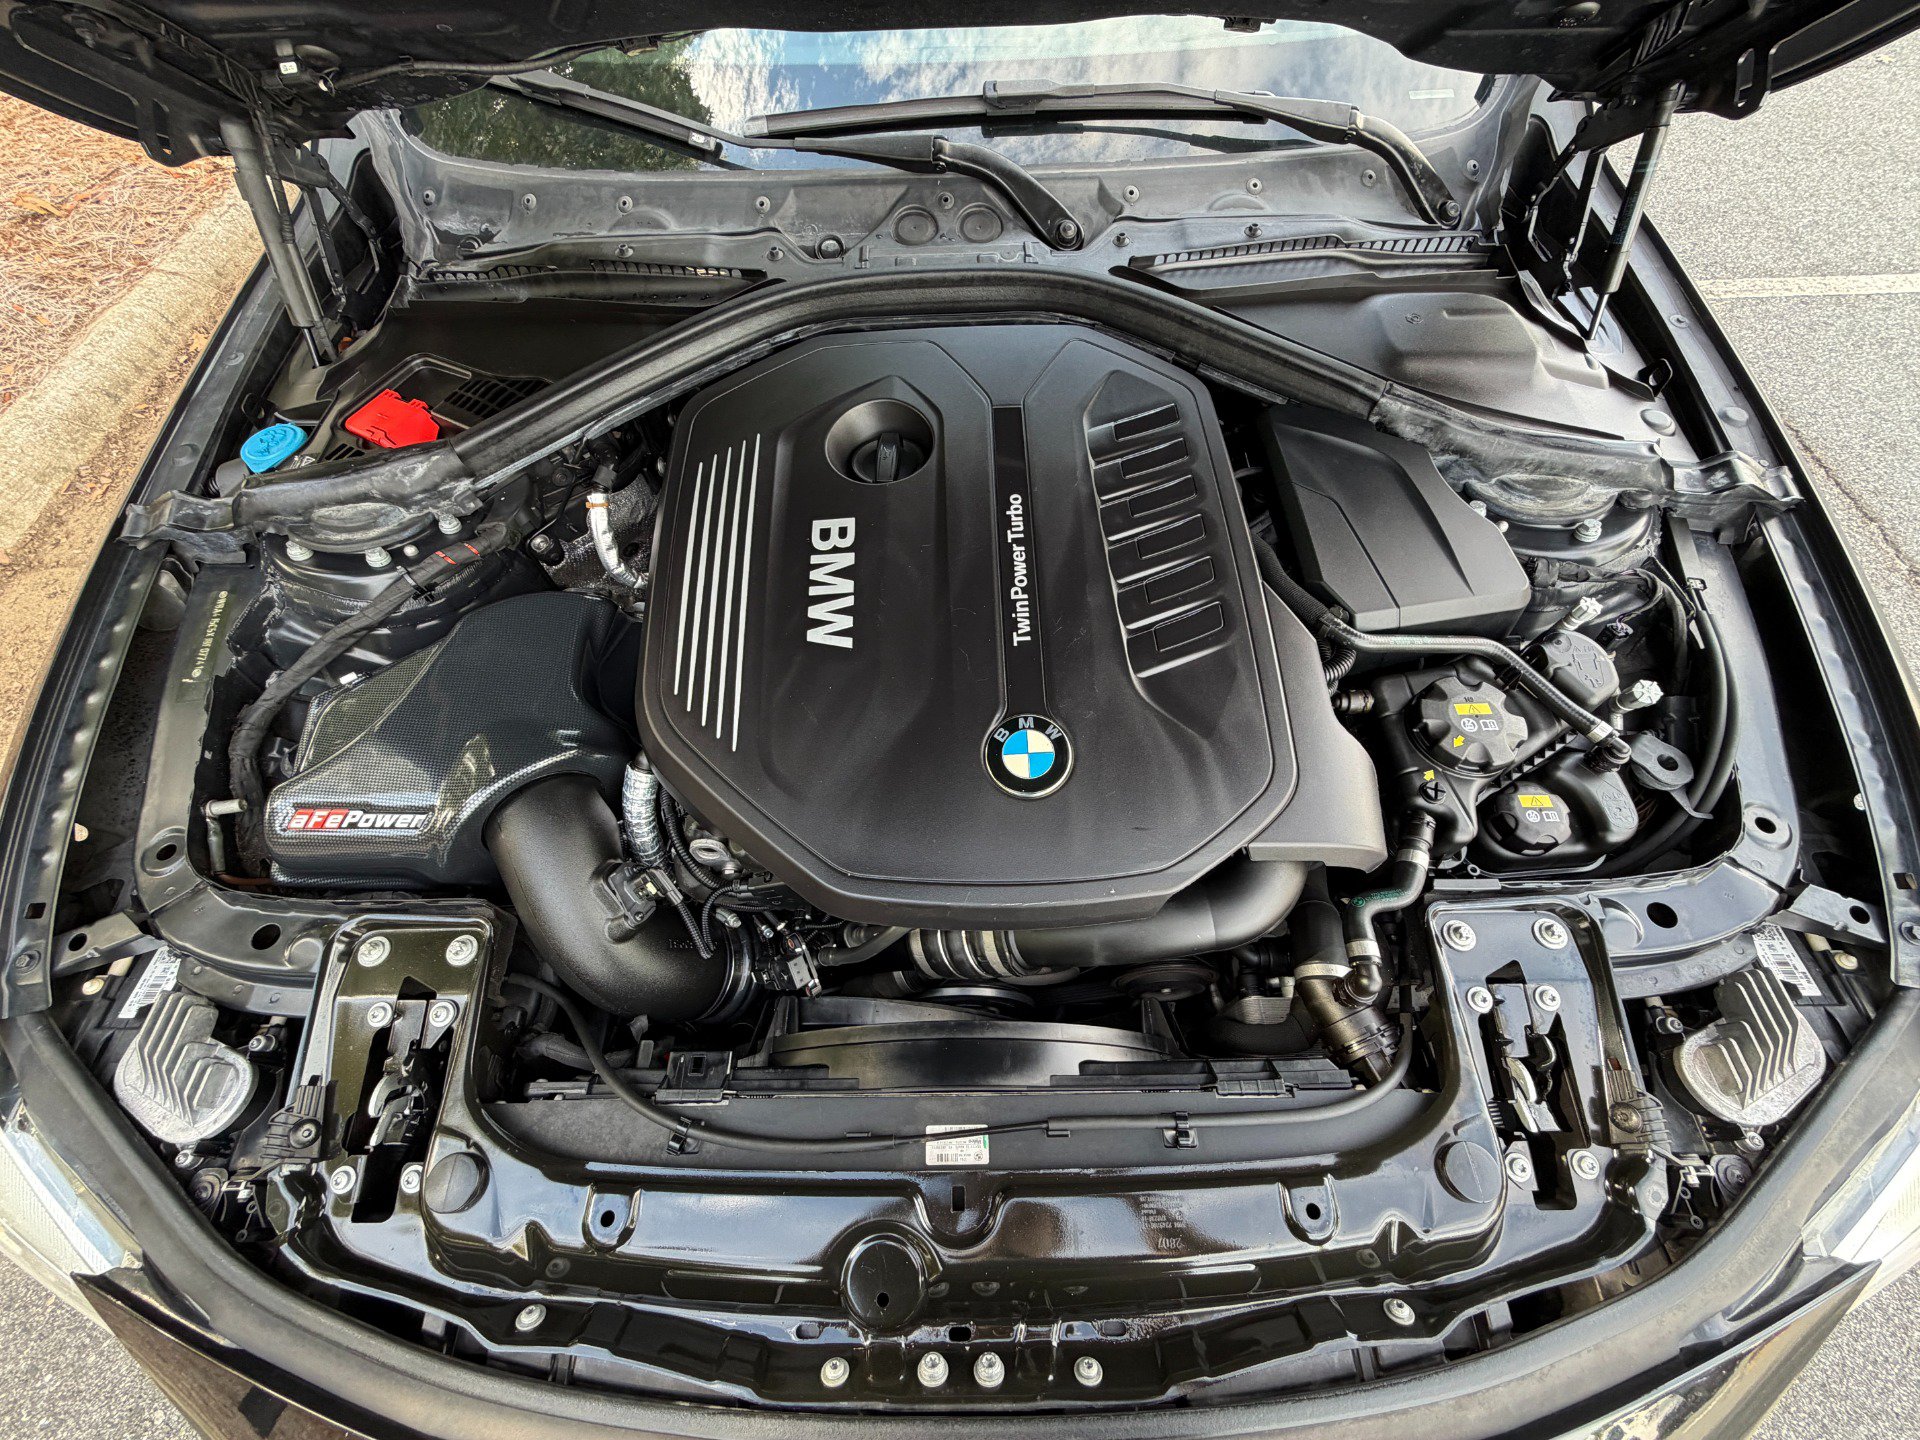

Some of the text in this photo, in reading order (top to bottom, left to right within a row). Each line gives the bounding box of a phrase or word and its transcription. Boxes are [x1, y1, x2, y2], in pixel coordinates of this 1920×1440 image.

[807, 517, 855, 648] BMW
[1006, 494, 1031, 646] TwinPower Turbo
[994, 717, 1062, 743] BMW
